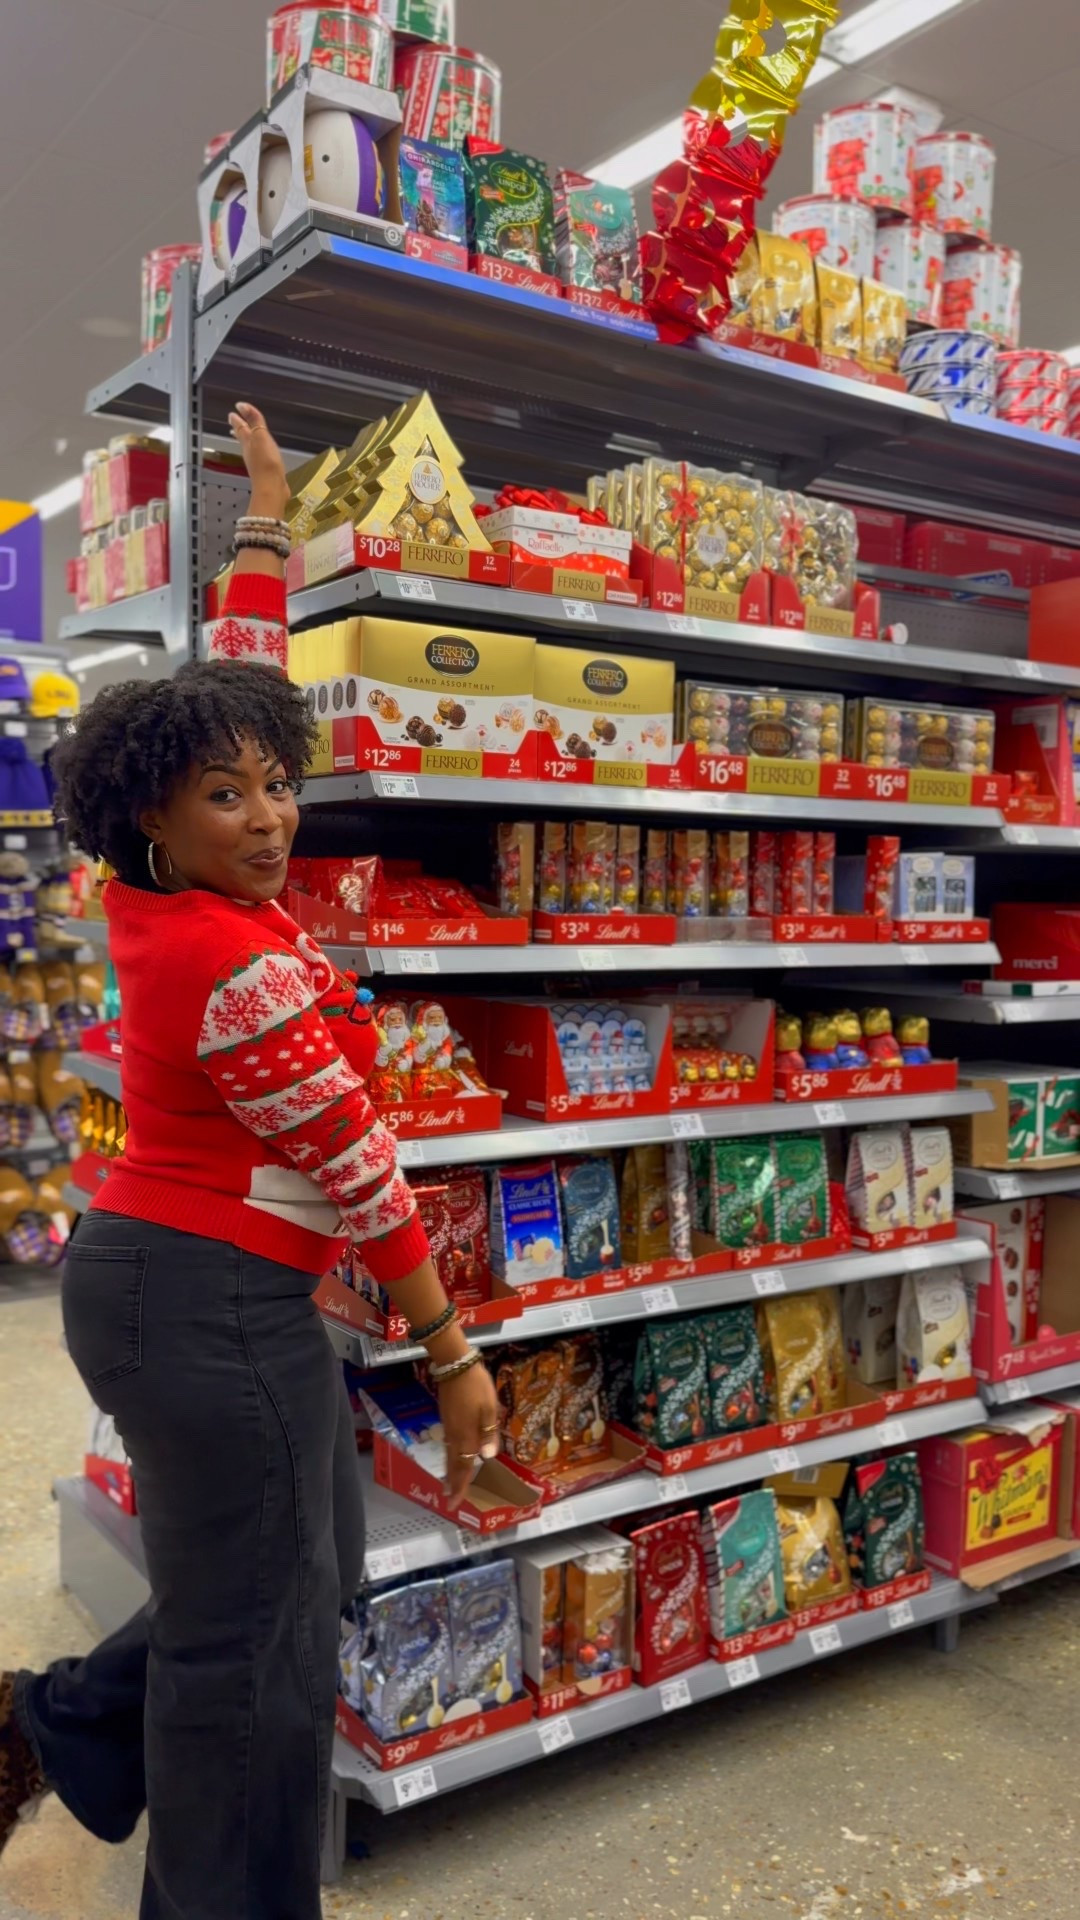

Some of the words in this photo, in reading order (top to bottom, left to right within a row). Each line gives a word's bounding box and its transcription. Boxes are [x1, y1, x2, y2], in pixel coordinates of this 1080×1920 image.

[498, 178, 526, 193] LINDOR
[518, 272, 553, 295] Lindt
[414, 473, 441, 483] FERRERO
[414, 480, 441, 491] ROCHER
[528, 537, 564, 553] Raffaello
[408, 545, 464, 566] FERRERO
[486, 556, 495, 565] 12
[558, 575, 601, 592] FERRERO
[689, 596, 737, 615] FERRERO
[431, 643, 475, 659] FERRERO
[431, 655, 474, 668] COLLECTION
[587, 667, 623, 682] FERRERO
[407, 676, 436, 686] GRAND
[441, 680, 496, 692] ASSORTMENT
[567, 697, 593, 705] GRAND
[595, 699, 642, 711] ASSORTMENT
[426, 754, 478, 771] FERRERO
[510, 758, 521, 768] 24
[598, 766, 643, 781] FERRERO
[669, 769, 680, 778] 24
[752, 765, 814, 786] FERRERO
[837, 769, 849, 782] 32
[912, 778, 967, 799] FERRERO
[985, 782, 997, 794] 32
[312, 922, 332, 939] Lindt
[426, 925, 468, 941] Lindt
[594, 923, 631, 939] Lindt
[808, 924, 840, 939] Lindt
[1013, 956, 1059, 970] merci
[847, 1072, 892, 1094] Lindt
[697, 1085, 732, 1101] Lindt
[589, 1095, 627, 1111] Lindt
[414, 1110, 456, 1128] Lindt
[511, 1182, 543, 1199] Lindt
[450, 1199, 471, 1209] NDOR
[772, 1247, 796, 1261] Lindt
[665, 1264, 688, 1278] Lindt
[552, 1282, 579, 1298] Lindt
[324, 1296, 344, 1314] Lindt
[816, 1415, 846, 1433] Lindt
[704, 1442, 737, 1462] Lindt
[410, 1483, 433, 1504] Lindt
[510, 1506, 536, 1523] Lindt
[894, 1580, 922, 1600] Lindt
[821, 1601, 853, 1619] Lindt
[755, 1625, 787, 1646] Lindt
[434, 1724, 476, 1750] Lindt
